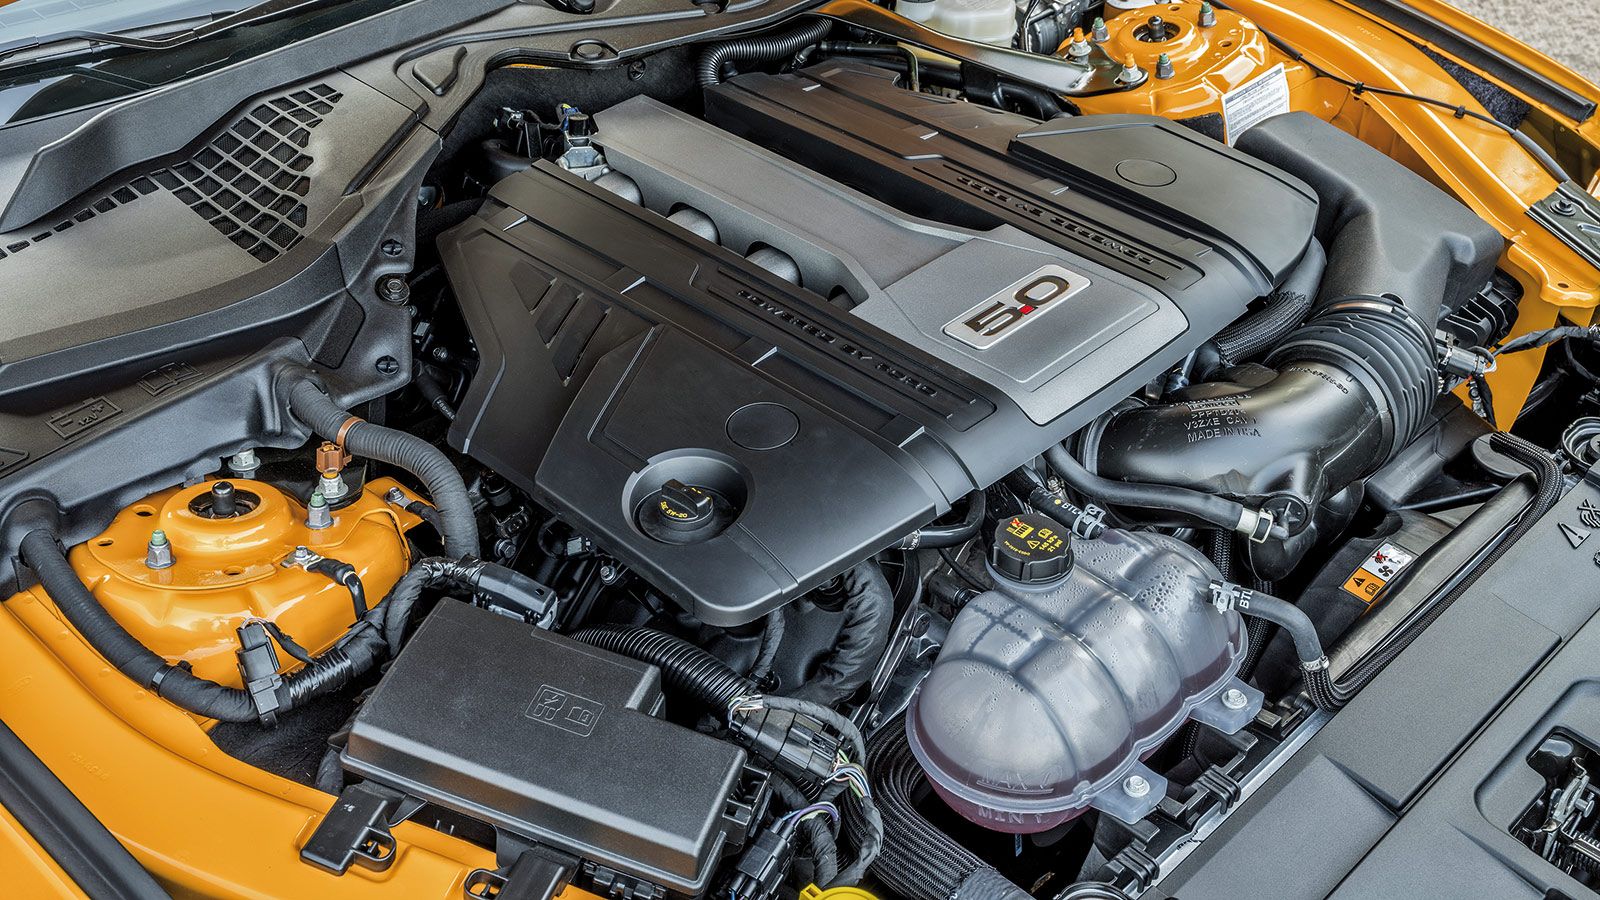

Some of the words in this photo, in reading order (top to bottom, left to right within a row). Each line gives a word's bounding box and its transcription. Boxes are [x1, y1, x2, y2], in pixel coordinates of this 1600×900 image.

[962, 274, 1071, 338] 5.0
[737, 289, 837, 344] POWERED
[841, 343, 873, 361] BY
[875, 362, 938, 398] FORD
[1187, 429, 1222, 443] MADE
[1222, 427, 1235, 437] IN
[1239, 590, 1253, 609] BTL
[978, 806, 1024, 824] MIN
